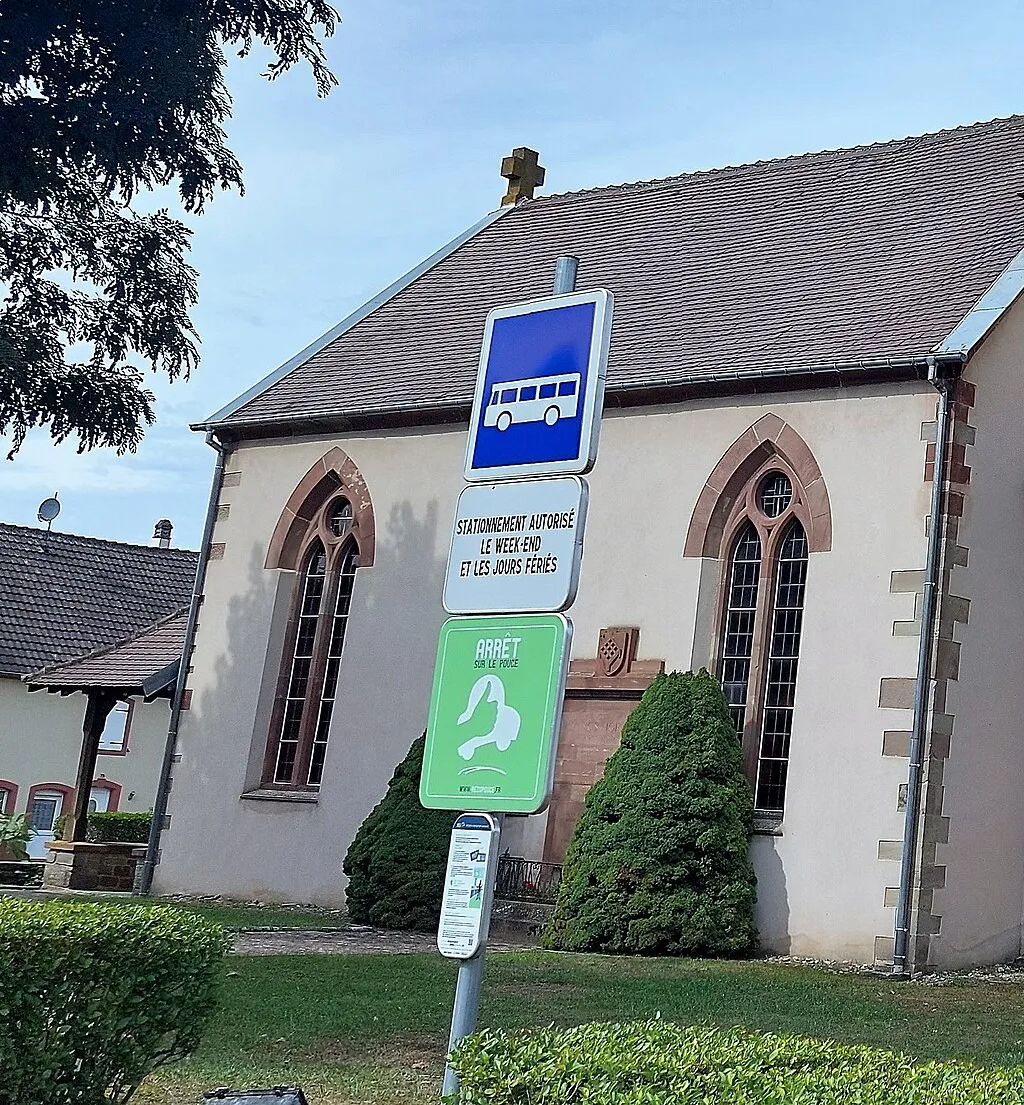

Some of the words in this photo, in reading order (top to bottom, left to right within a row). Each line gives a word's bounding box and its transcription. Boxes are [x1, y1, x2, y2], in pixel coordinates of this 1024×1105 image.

[457, 515, 527, 535] STATIONNEMENT
[529, 508, 575, 531] AUTORISÉ
[480, 538, 492, 555] LE
[495, 535, 541, 554] WEEK-END
[460, 560, 471, 577] ET
[474, 560, 490, 576] LES
[493, 558, 522, 575] JOURS
[525, 553, 557, 574] FÉRIÉS
[475, 632, 521, 659] ARRÊT
[474, 659, 486, 669] SUR
[488, 659, 496, 669] LE
[499, 658, 519, 668] POUCE
